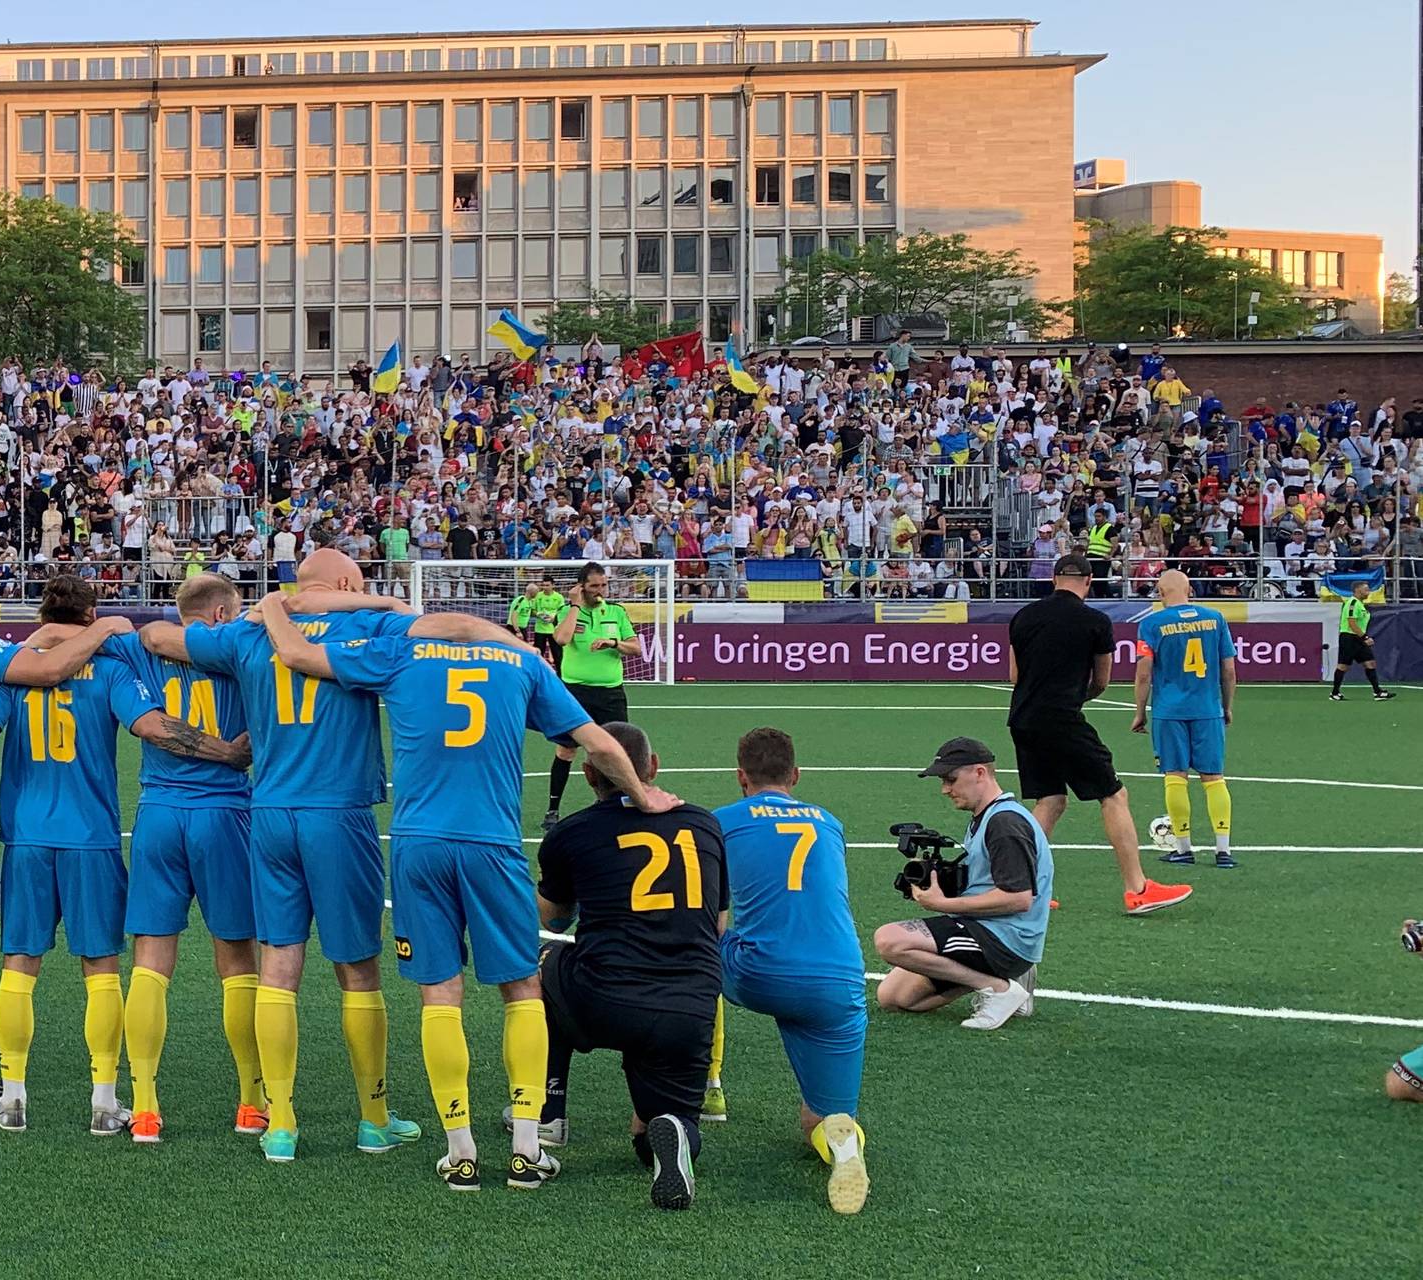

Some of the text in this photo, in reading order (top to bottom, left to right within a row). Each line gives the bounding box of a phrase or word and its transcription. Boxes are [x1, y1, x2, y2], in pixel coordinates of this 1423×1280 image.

[413, 643, 522, 668] SANDETSKYI
[639, 633, 700, 663] Wir
[714, 633, 850, 672] bringen
[864, 633, 1001, 672] Energie
[1183, 637, 1208, 679] 4
[23, 687, 76, 763] 16
[163, 677, 221, 738] 14
[444, 668, 489, 747] 5
[749, 805, 825, 822] MELNYK
[616, 829, 703, 912] 21
[775, 822, 818, 891] 7
